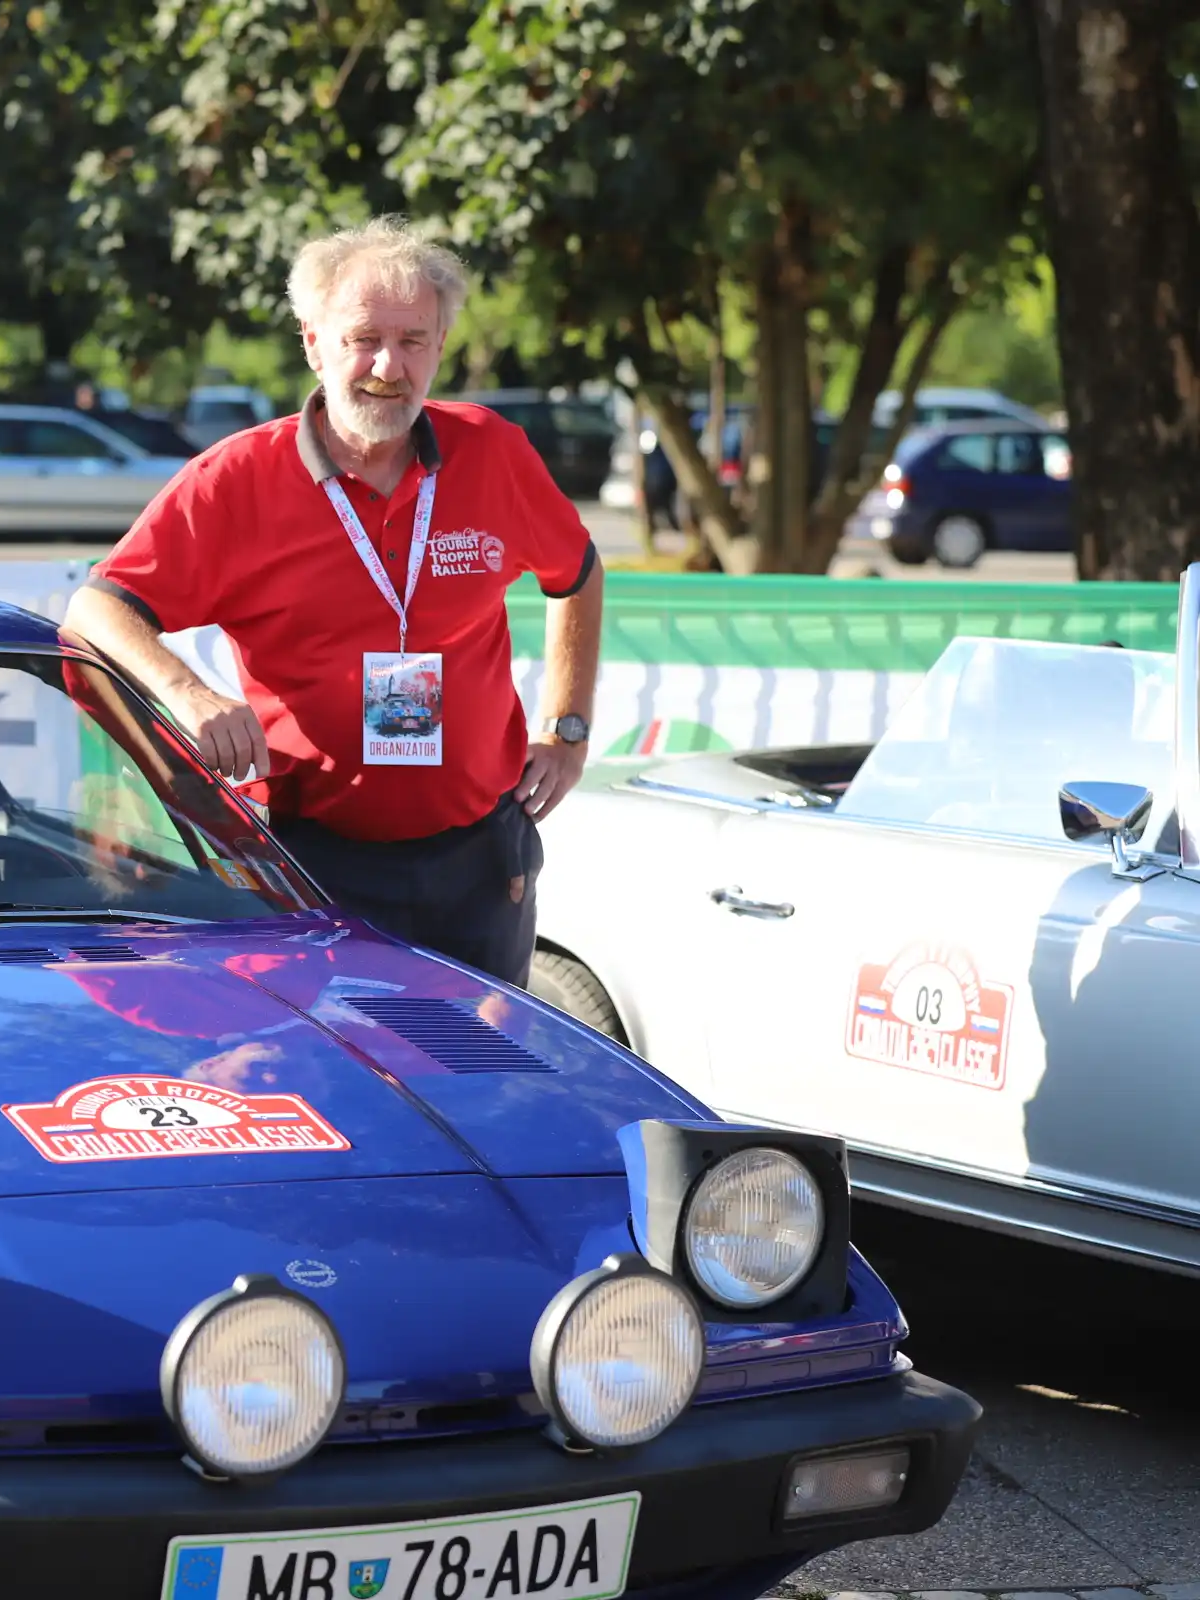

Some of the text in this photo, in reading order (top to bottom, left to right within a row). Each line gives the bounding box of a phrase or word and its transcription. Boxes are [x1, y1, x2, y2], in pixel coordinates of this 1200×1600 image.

[427, 537, 480, 554] TOURIST
[429, 549, 480, 565] TROPHY
[431, 562, 471, 577] RALLY
[369, 741, 437, 757] ORGANIZATOR
[916, 985, 943, 1025] 03
[71, 1080, 258, 1120] TOURIST TROPHY
[139, 1106, 198, 1127] 23
[52, 1125, 328, 1158] CROATIA 2024 CLASSIC
[246, 1517, 599, 1600] MB 78-ADA
